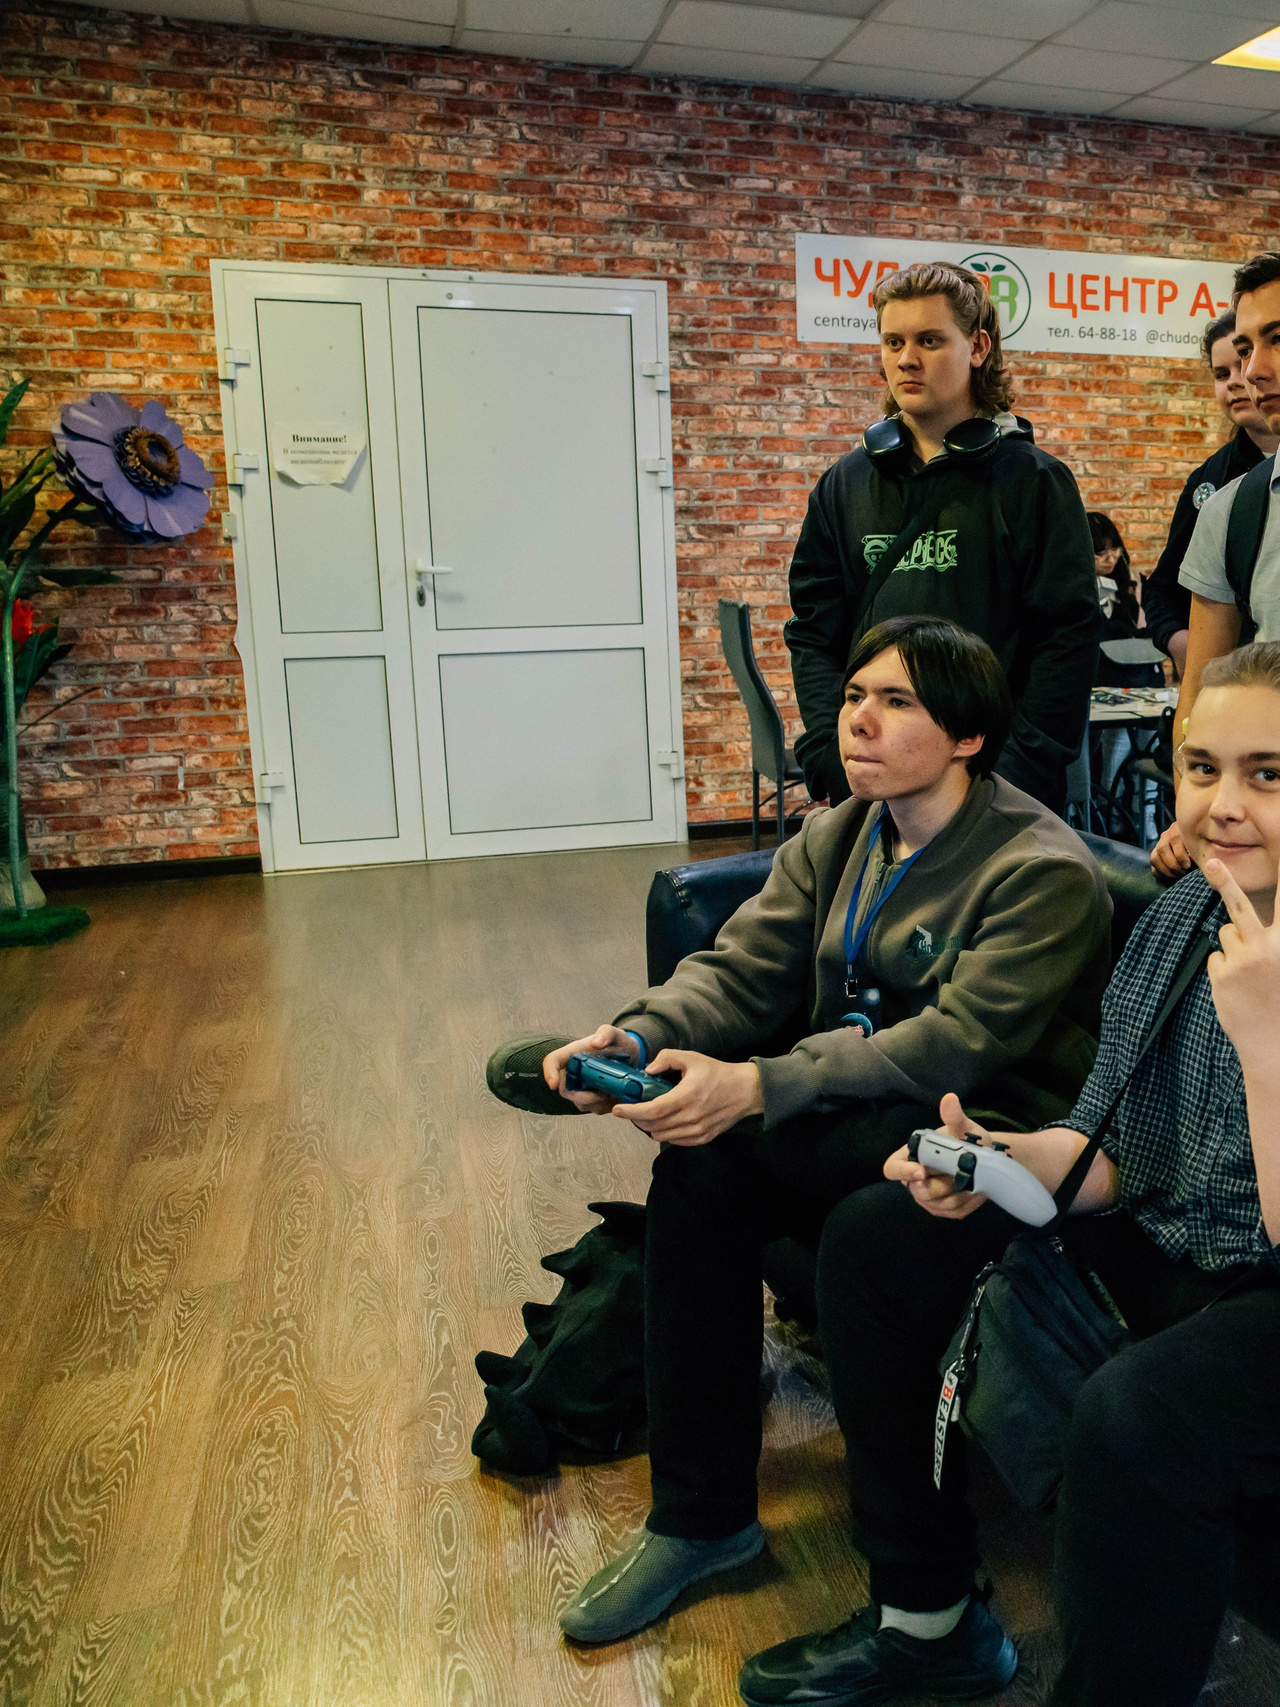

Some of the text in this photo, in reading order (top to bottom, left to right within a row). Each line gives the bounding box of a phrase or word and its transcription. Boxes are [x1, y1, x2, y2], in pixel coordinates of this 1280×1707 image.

[1048, 271, 1179, 318] ЦЕНТР
[1047, 326, 1074, 339] тел.
[1078, 326, 1138, 342] 64-88-18
[292, 434, 347, 443] Внимание!
[935, 1384, 954, 1482] BEASTARS
